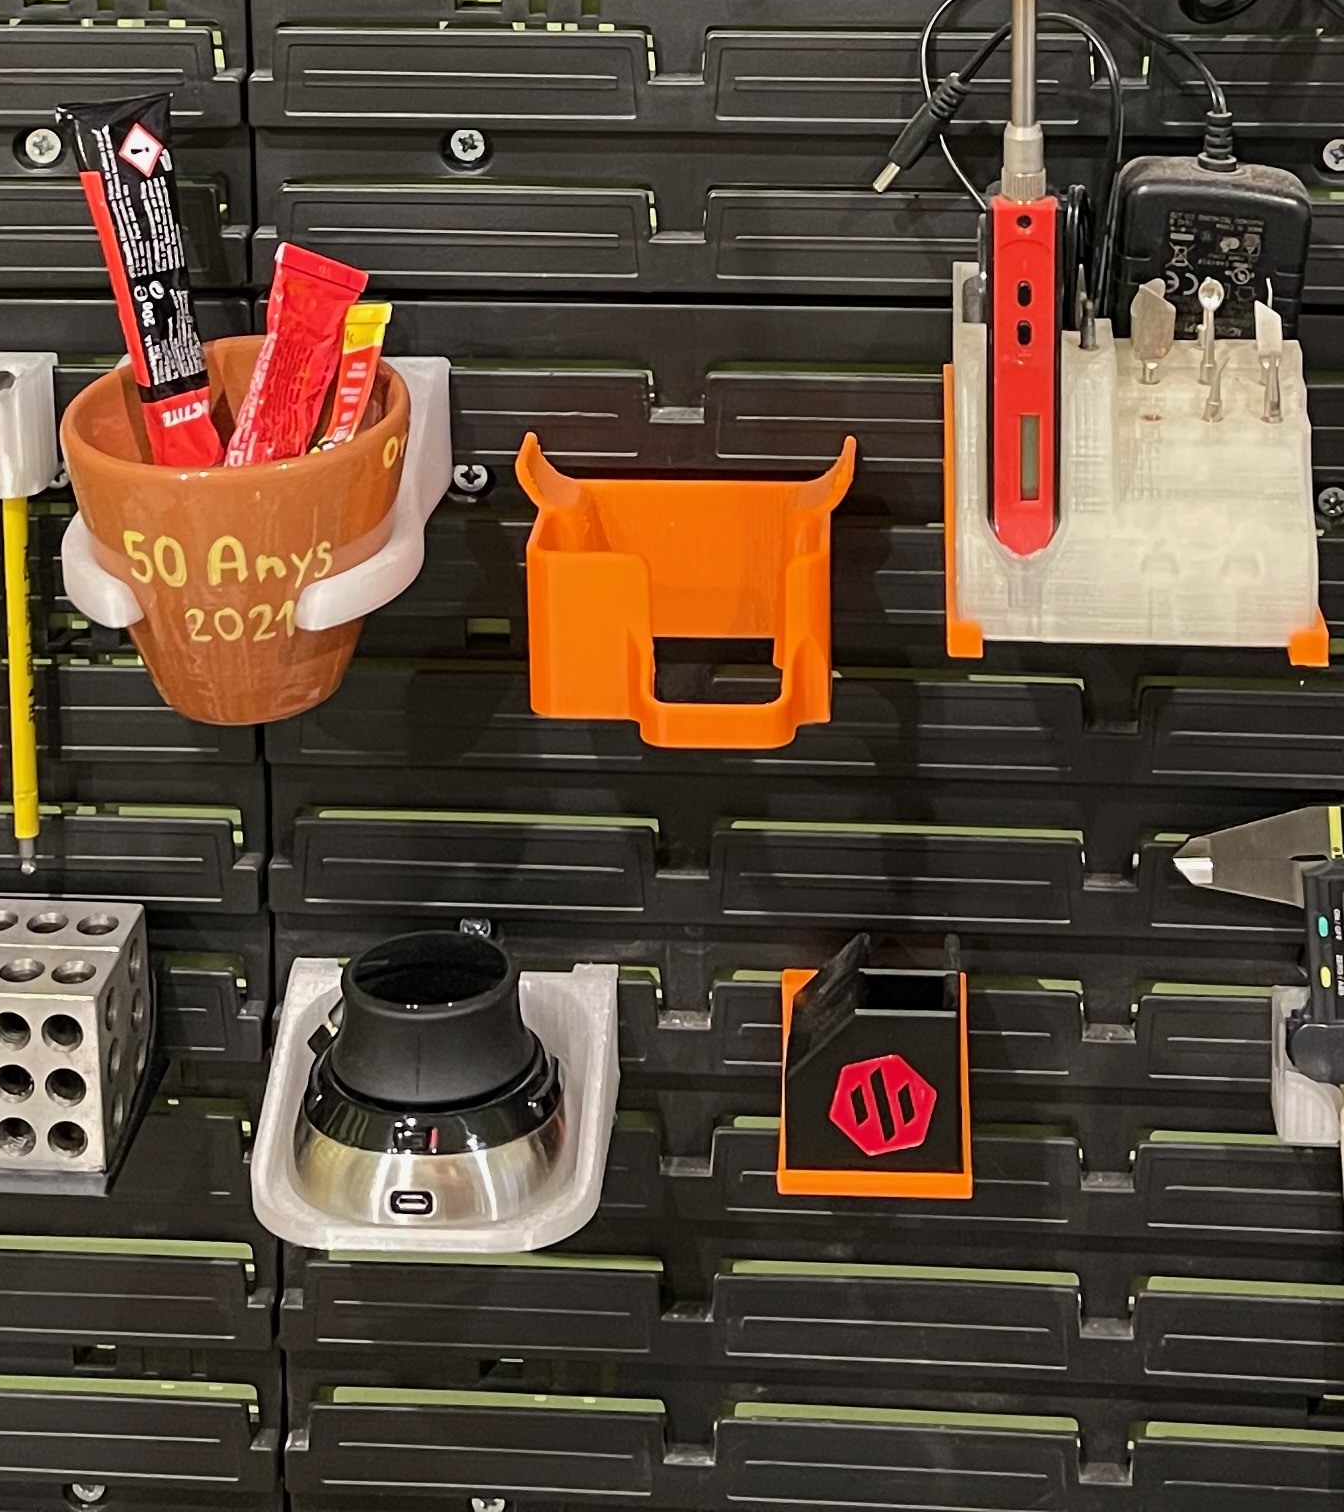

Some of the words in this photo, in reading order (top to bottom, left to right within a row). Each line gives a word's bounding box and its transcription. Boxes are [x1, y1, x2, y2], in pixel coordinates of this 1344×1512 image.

[123, 529, 188, 588] 50
[207, 534, 335, 589] Anys
[185, 599, 298, 643] 2021
